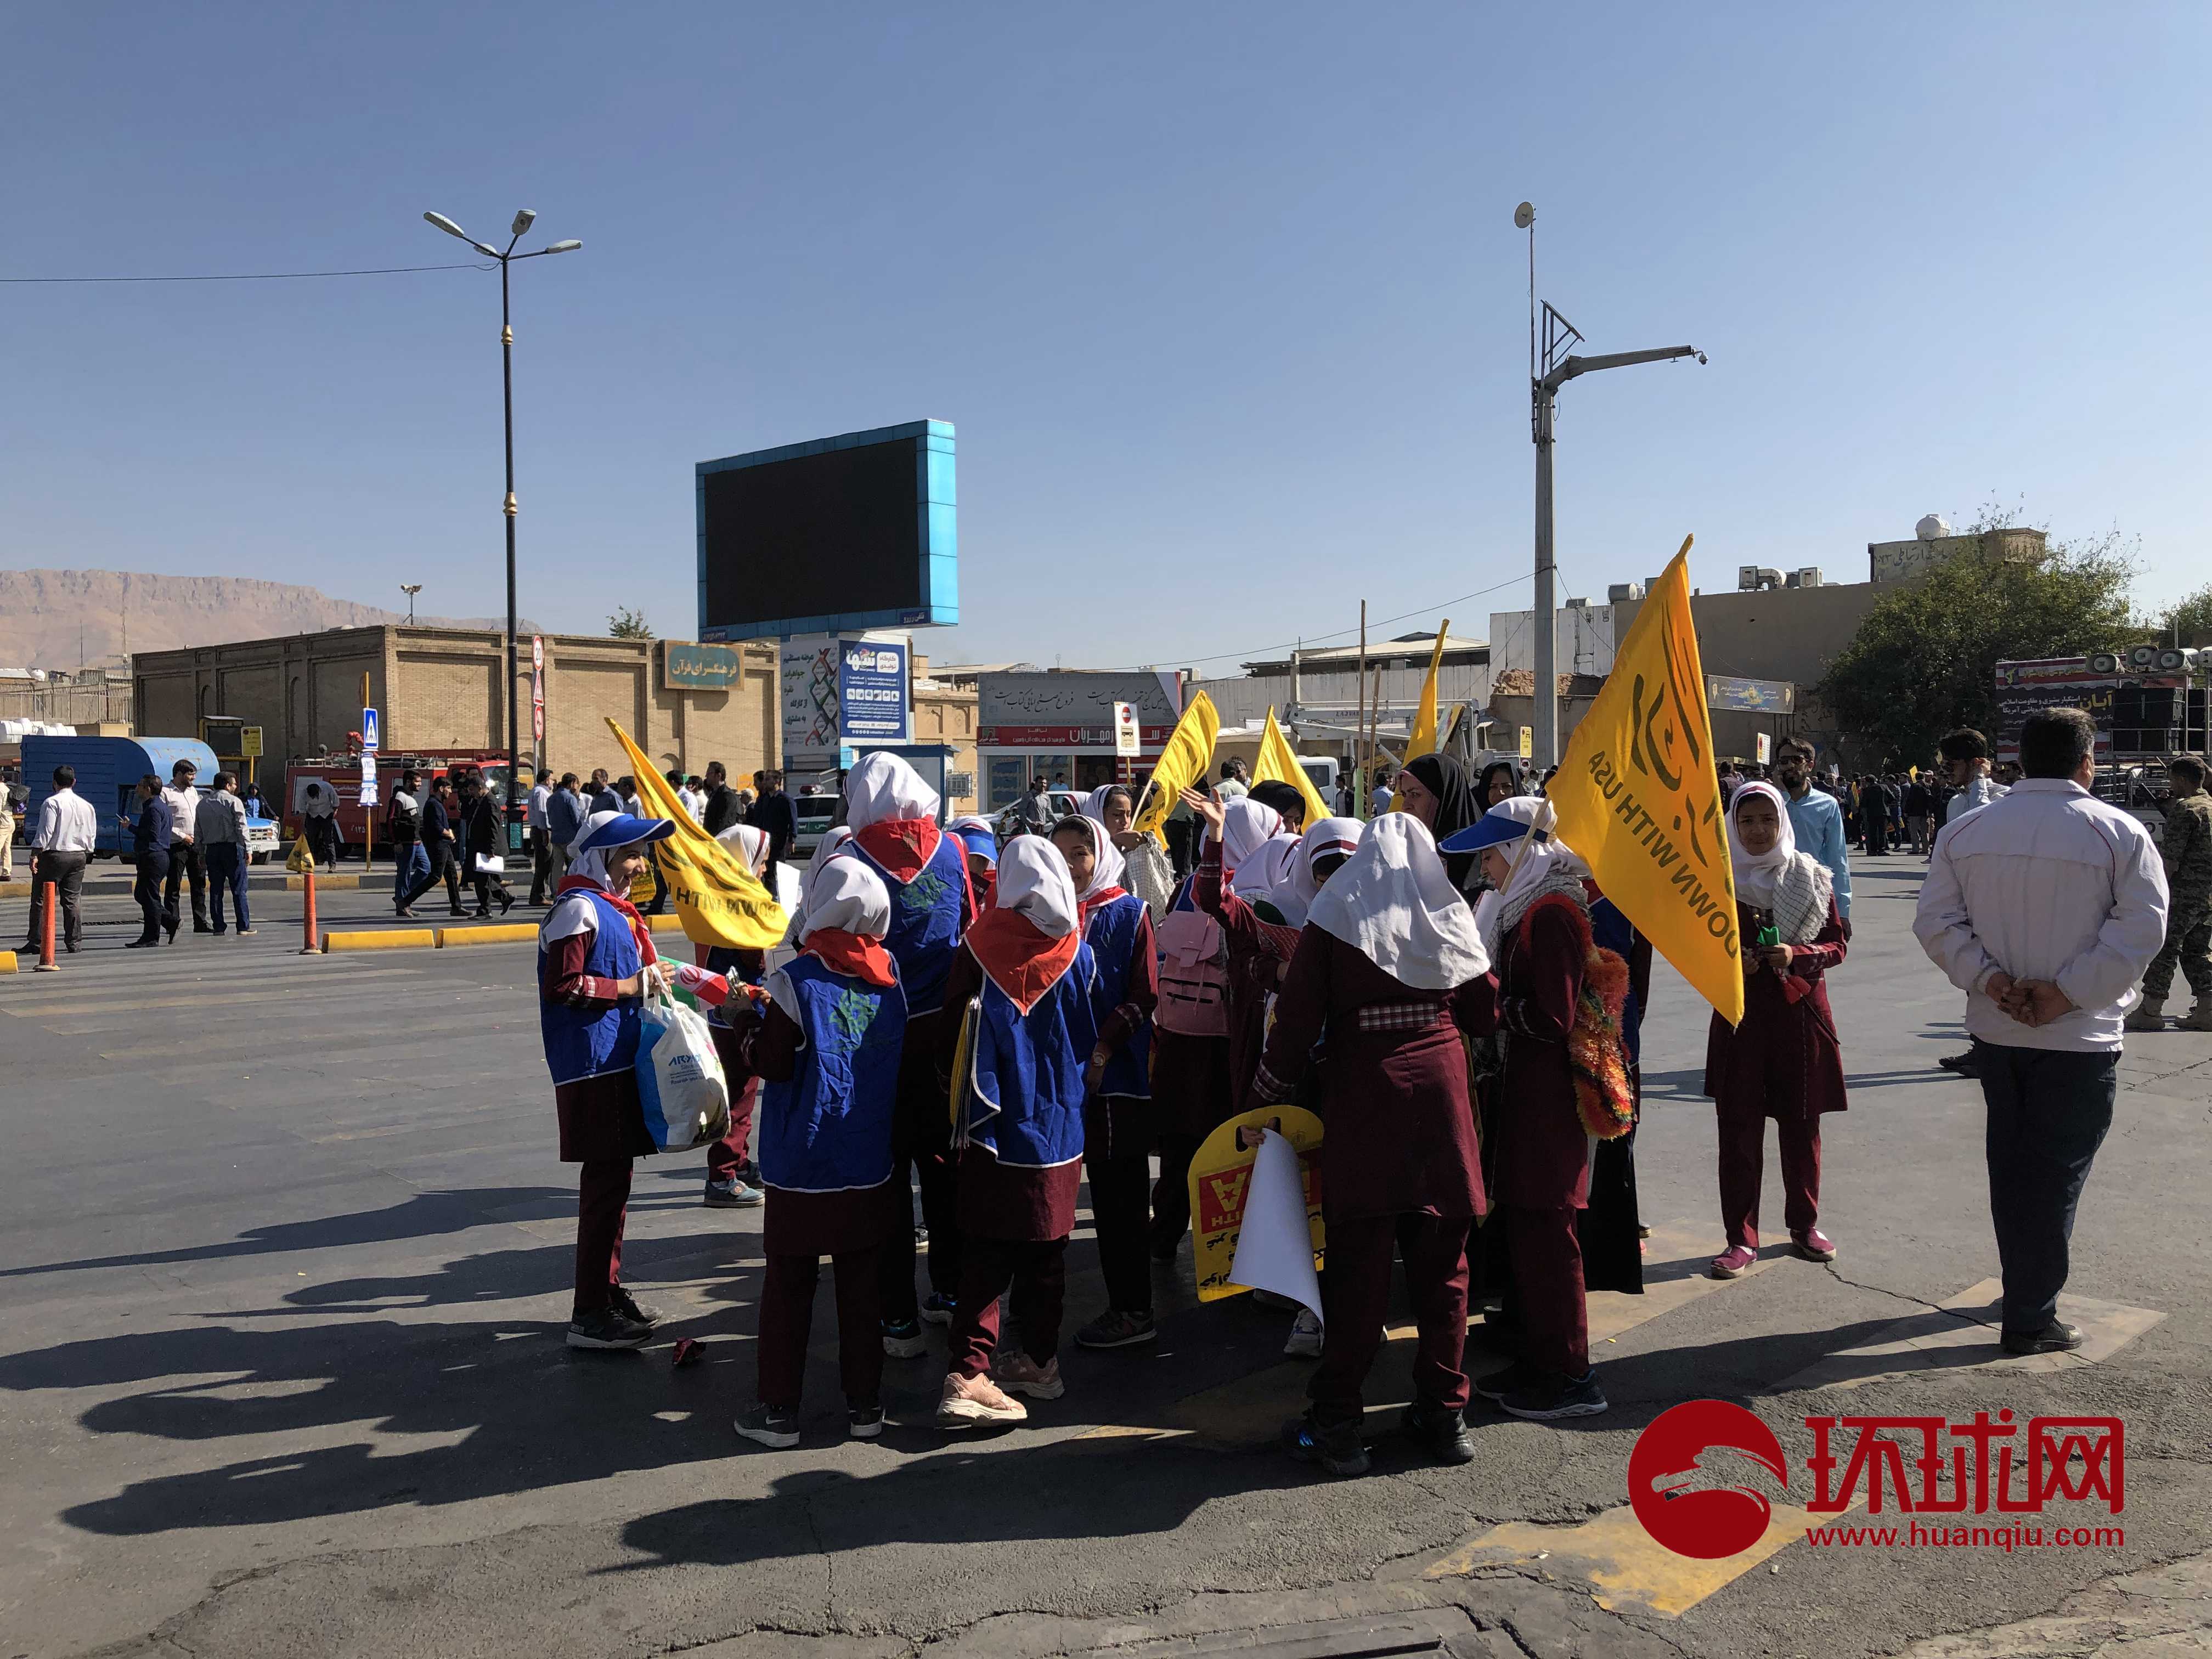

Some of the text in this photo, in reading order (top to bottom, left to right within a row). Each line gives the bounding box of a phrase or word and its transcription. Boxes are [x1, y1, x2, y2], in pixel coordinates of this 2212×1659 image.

[672, 659, 691, 675] قرآن
[995, 692, 1013, 706] است
[1006, 689, 1032, 710] کتاب
[1087, 692, 1105, 706] است
[2080, 689, 2114, 712] آبان
[1211, 1210, 1243, 1227] ITH
